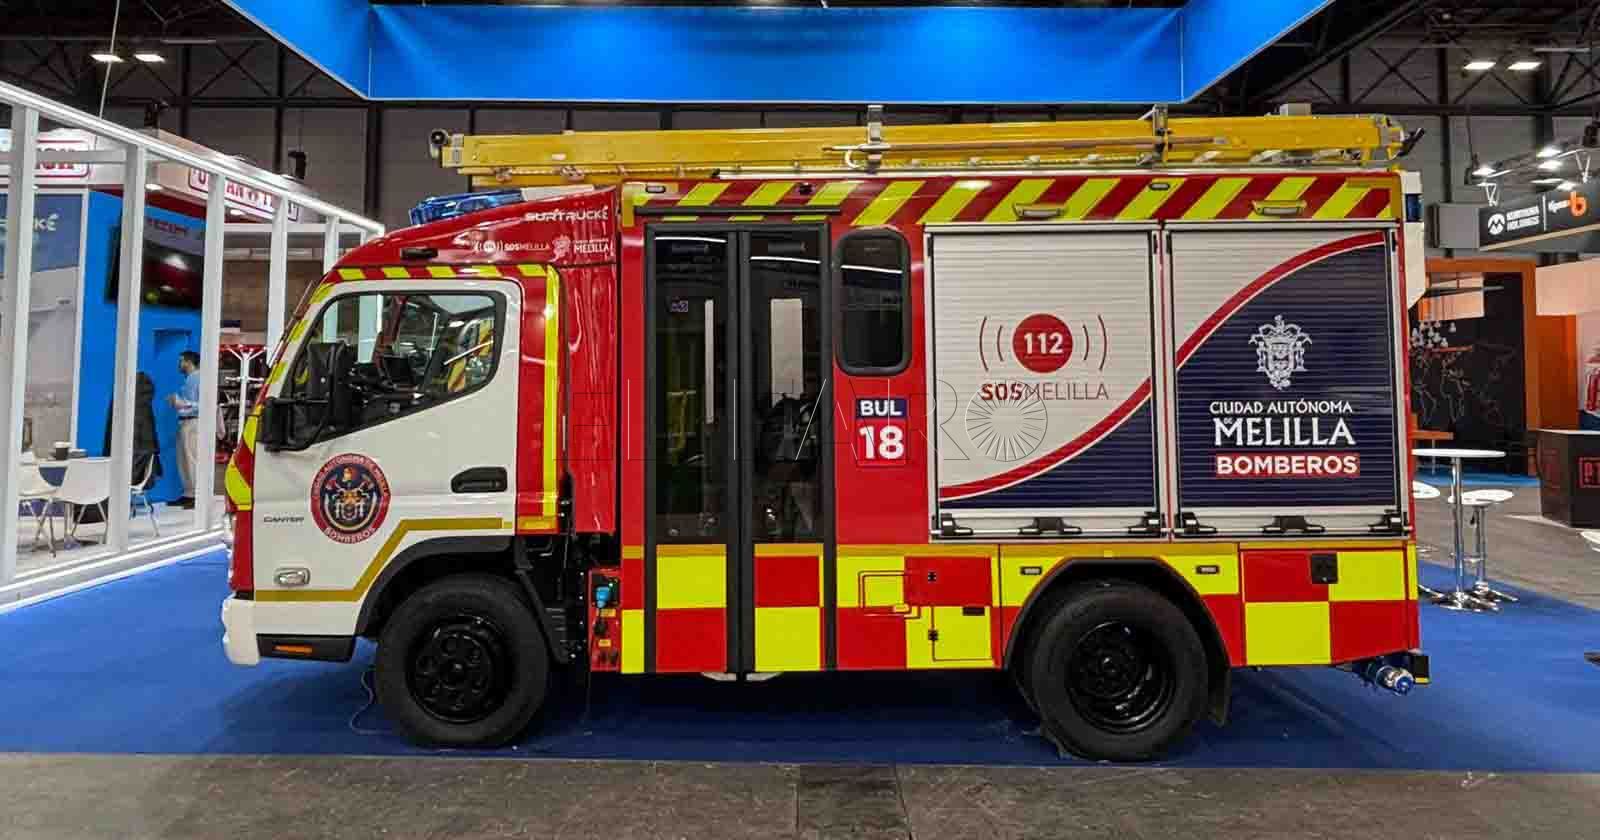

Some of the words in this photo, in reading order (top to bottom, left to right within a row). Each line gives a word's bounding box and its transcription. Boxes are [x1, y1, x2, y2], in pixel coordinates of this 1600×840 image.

[573, 243, 610, 254] MELILLA
[1023, 331, 1065, 355] 112
[859, 400, 902, 417] BUL
[1209, 401, 1263, 415] CIUDAD
[1268, 398, 1352, 414] AUTÓNOMA
[1212, 417, 1357, 447] MELILLA
[858, 425, 905, 460] 18
[1217, 456, 1359, 475] BOMBEROS
[323, 526, 377, 545] BOMBEROS
